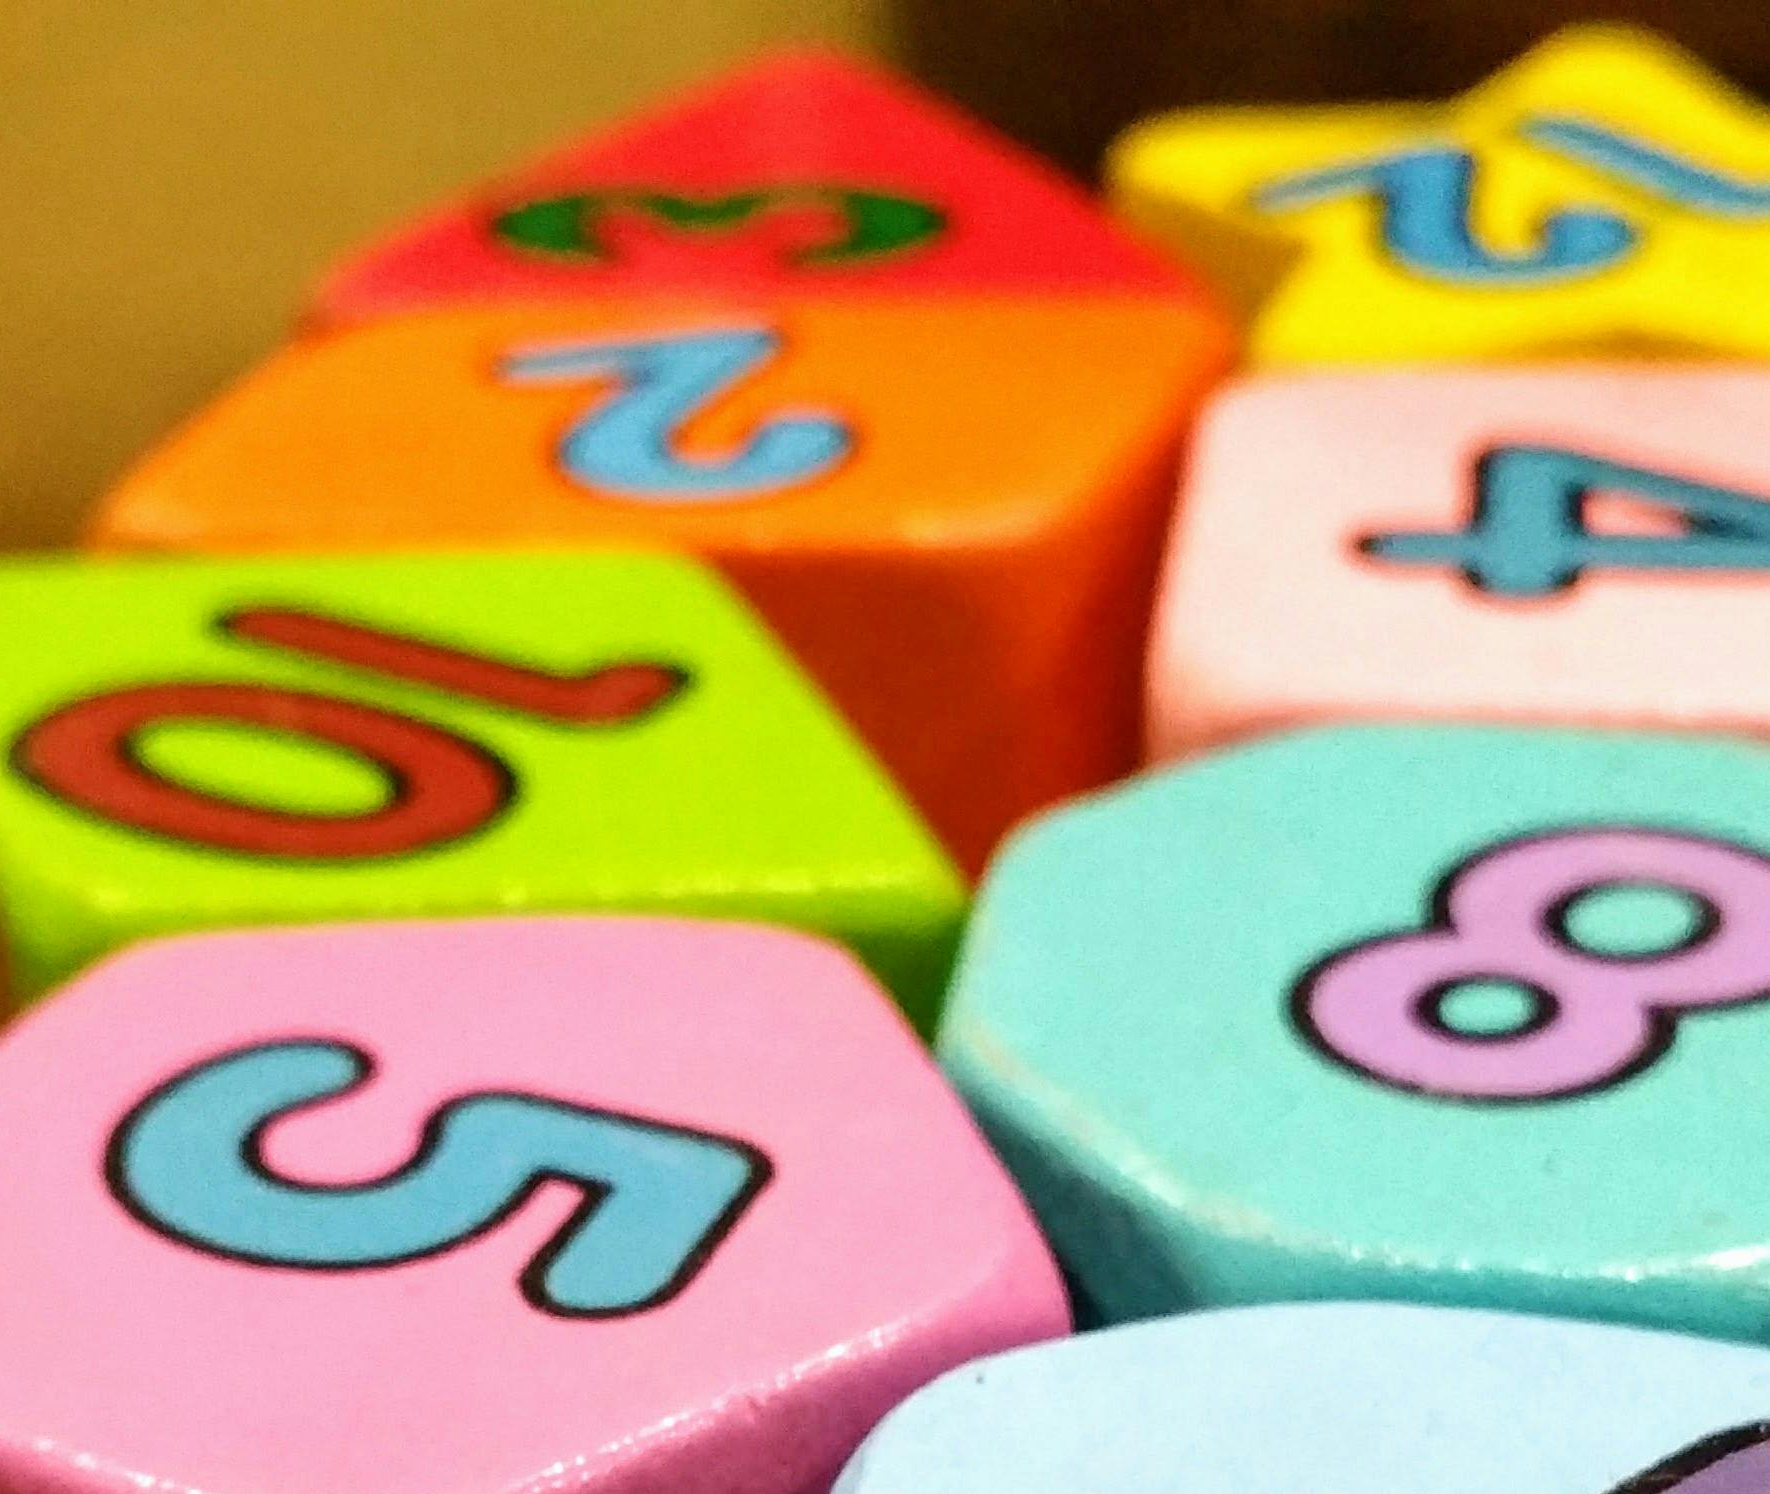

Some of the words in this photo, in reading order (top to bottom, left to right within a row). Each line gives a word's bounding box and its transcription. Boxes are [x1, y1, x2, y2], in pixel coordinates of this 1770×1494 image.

[491, 184, 947, 266] 3
[495, 324, 853, 500] 2
[9, 606, 693, 864] 10
[105, 1038, 775, 1320] 5
